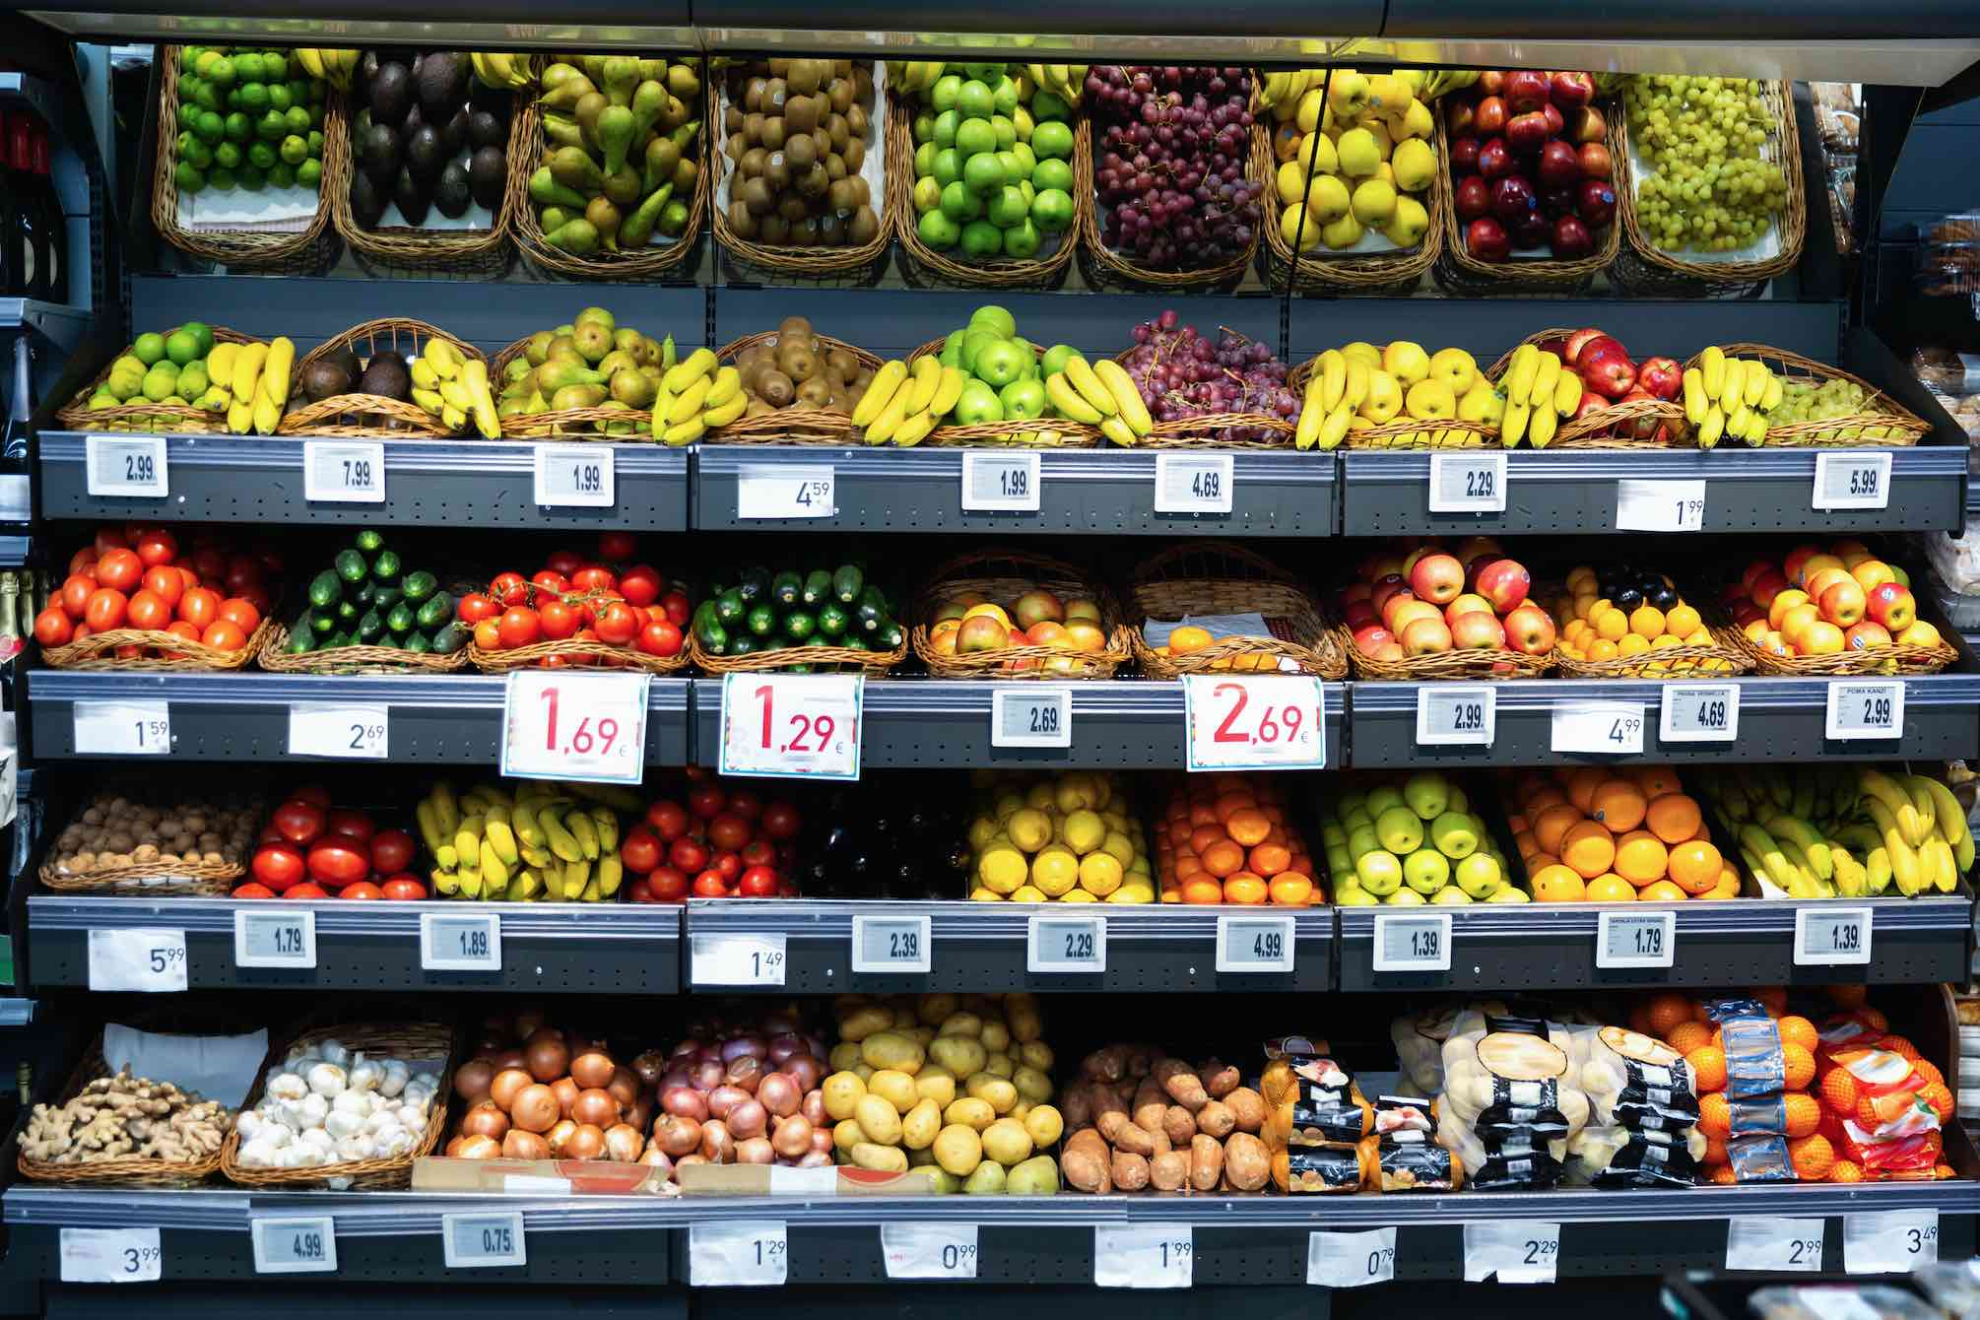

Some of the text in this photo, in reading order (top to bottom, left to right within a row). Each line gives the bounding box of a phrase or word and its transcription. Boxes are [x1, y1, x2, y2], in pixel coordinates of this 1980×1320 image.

[126, 455, 153, 481] 2.99
[343, 460, 371, 487] 7.99
[573, 465, 600, 491] 1.99
[1001, 470, 1027, 495] 1.99
[1192, 472, 1218, 497] 4.69
[1466, 471, 1492, 496] 2.29
[1850, 469, 1877, 494] 5.99
[1030, 707, 1057, 732] 2.69
[1454, 704, 1481, 729] 2.99
[1697, 701, 1725, 726] 4.69
[1863, 698, 1890, 724] 2.99
[274, 927, 301, 952] 1.79
[459, 931, 487, 955] 1.89
[890, 932, 917, 957] 2.39
[1065, 933, 1092, 958] 2.29
[1254, 933, 1281, 958] 4.99
[1411, 931, 1437, 956] 1.39
[1634, 928, 1661, 953] 1.79
[1832, 925, 1858, 950] 1.39
[293, 1233, 321, 1258] 4.99
[483, 1228, 511, 1254] 0.75
